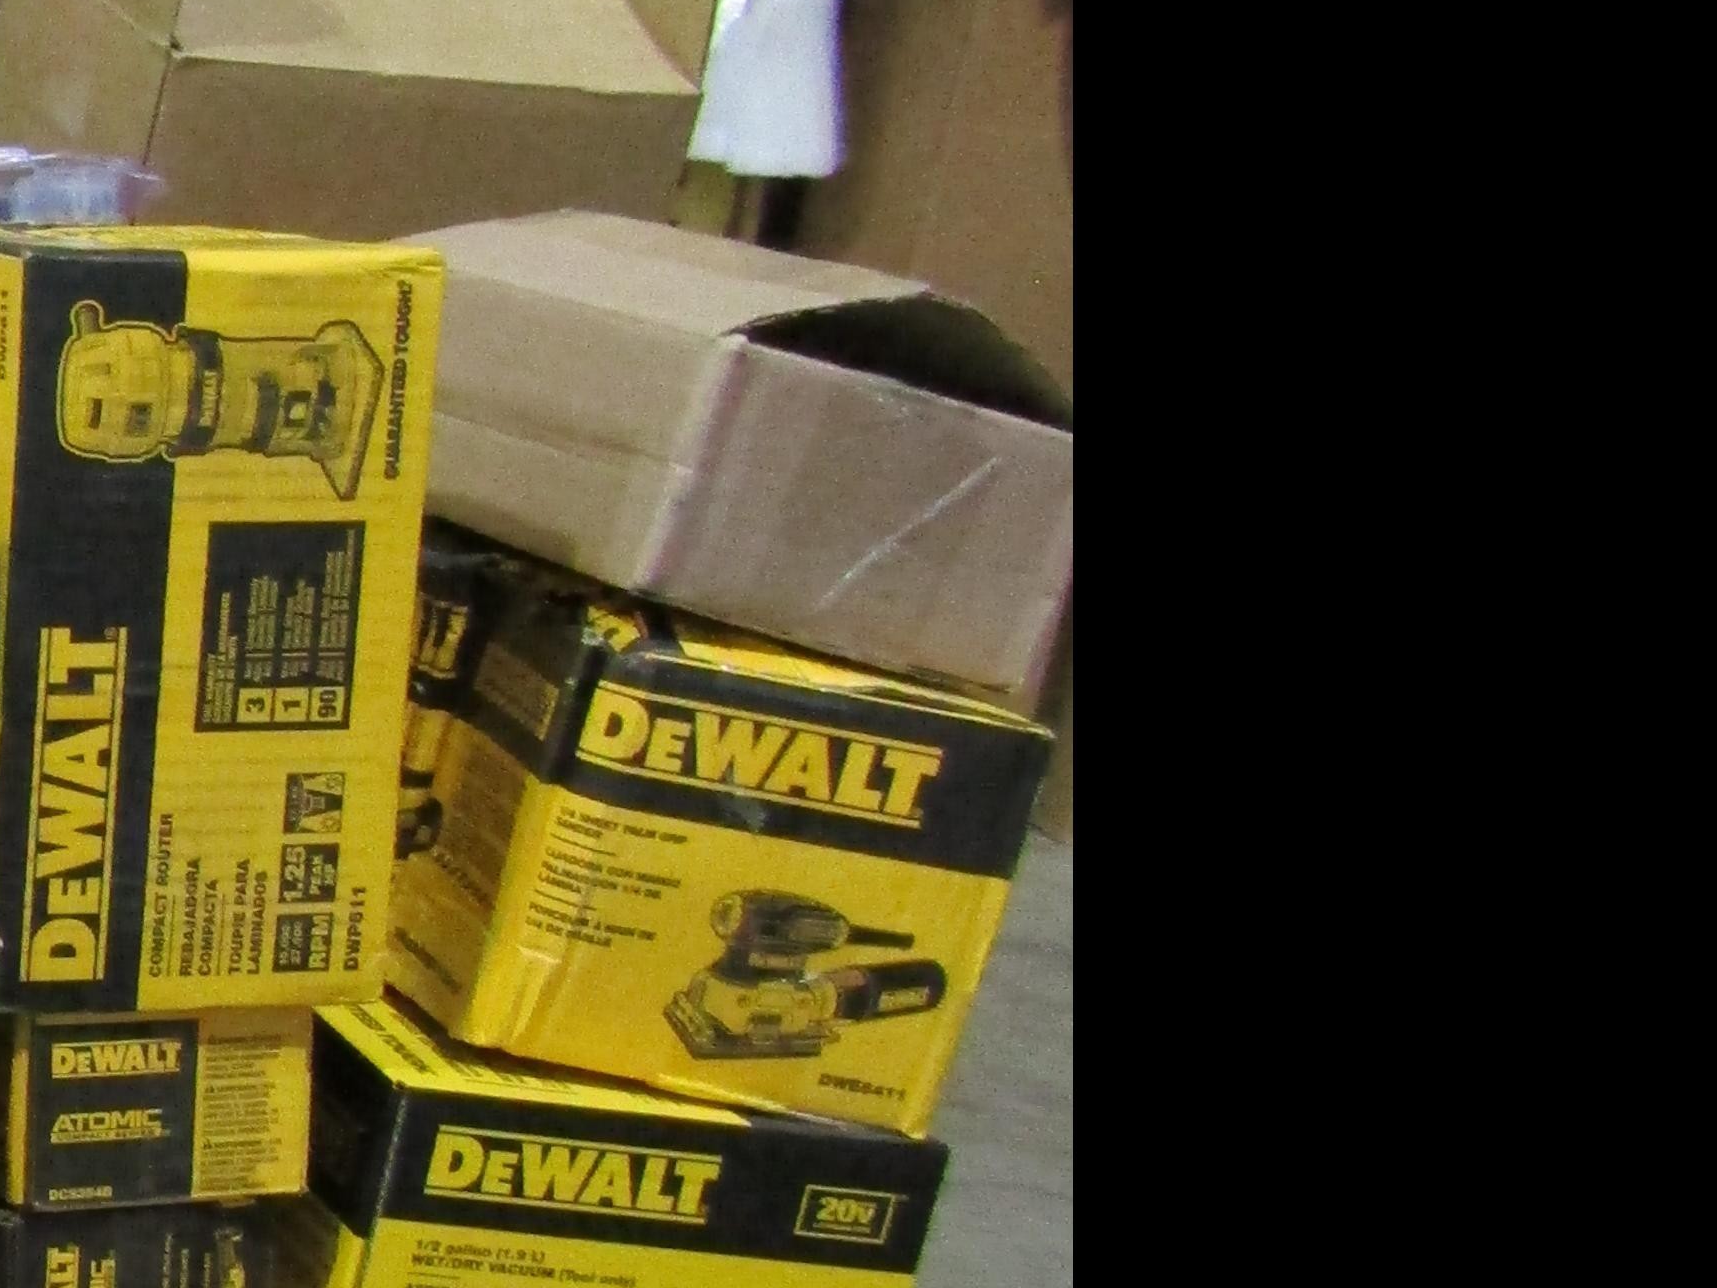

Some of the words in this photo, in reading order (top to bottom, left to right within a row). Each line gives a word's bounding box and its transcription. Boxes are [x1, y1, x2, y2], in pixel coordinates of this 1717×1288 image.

[246, 697, 265, 713] 3
[283, 699, 301, 712] 1
[317, 689, 338, 718] 90
[579, 692, 940, 821] DEWALT
[29, 628, 118, 982] DEWALT
[155, 814, 173, 886] ROUTER
[283, 846, 306, 901] 1.25
[234, 859, 250, 906] PARA
[149, 892, 167, 978] COMPACT
[198, 879, 218, 976] COMPACTA
[309, 913, 332, 971] RPM
[344, 887, 366, 971] DWP611
[52, 1041, 181, 1077] DEWALT
[53, 1110, 162, 1133] ATOMIC
[427, 1133, 720, 1215] DEWALT
